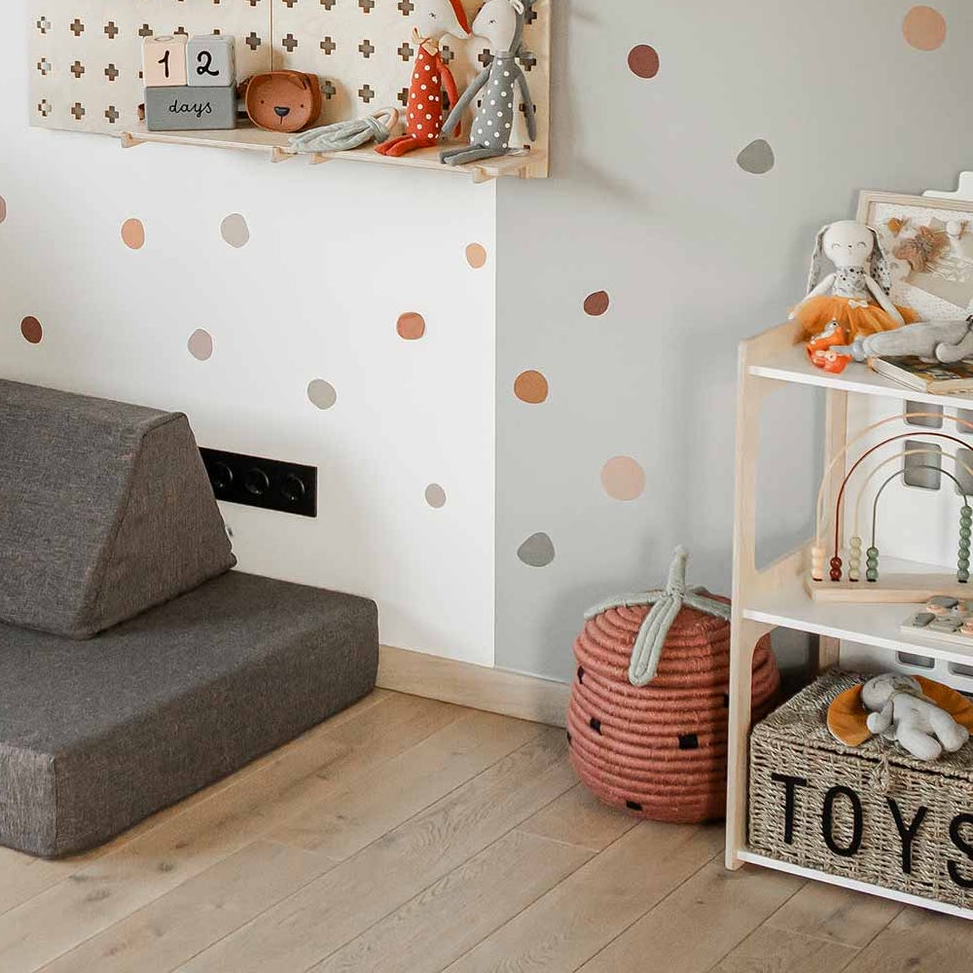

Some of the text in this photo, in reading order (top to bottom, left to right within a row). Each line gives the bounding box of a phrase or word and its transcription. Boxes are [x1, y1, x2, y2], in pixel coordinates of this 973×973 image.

[196, 50, 220, 76] 2
[168, 99, 213, 118] days
[771, 772, 973, 888] TOYS
